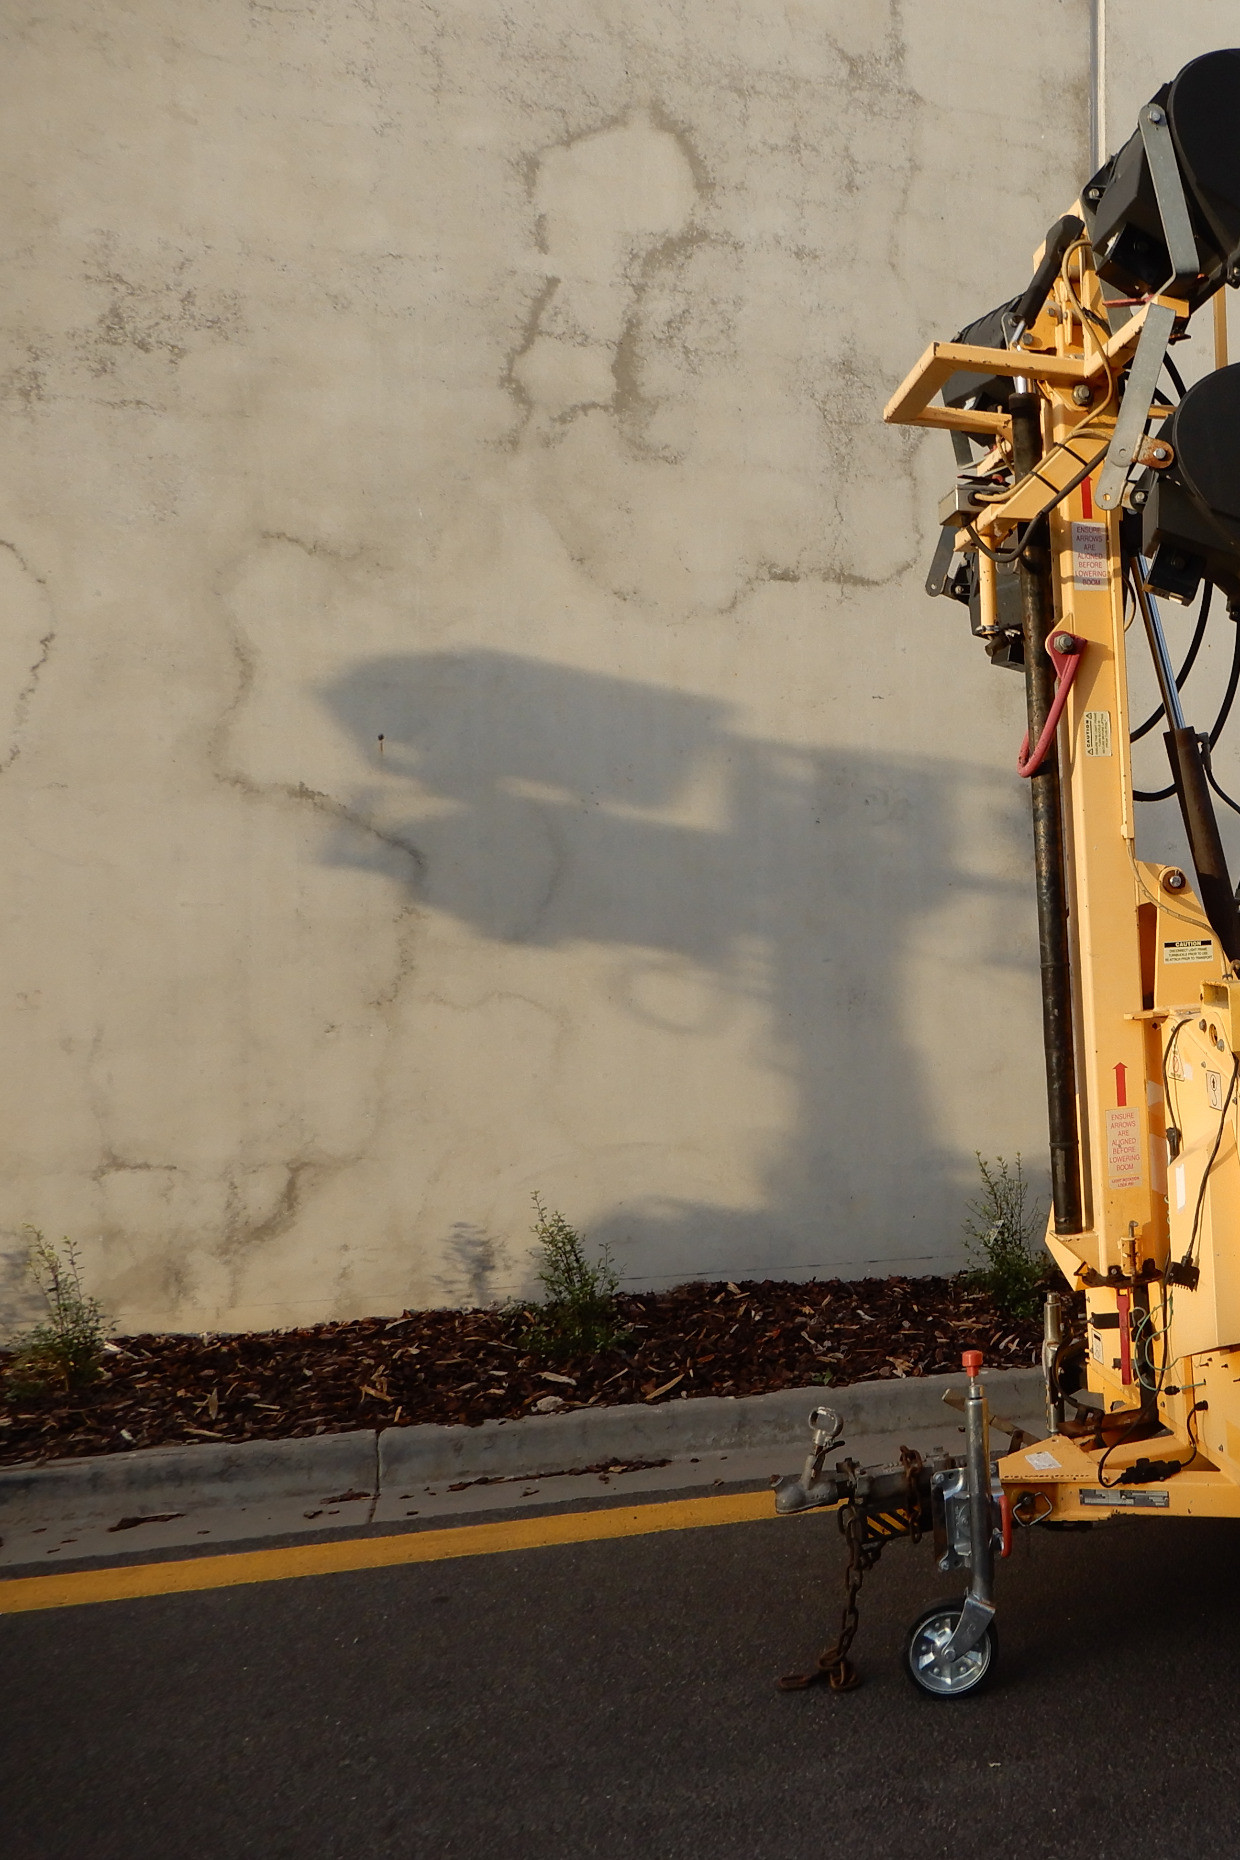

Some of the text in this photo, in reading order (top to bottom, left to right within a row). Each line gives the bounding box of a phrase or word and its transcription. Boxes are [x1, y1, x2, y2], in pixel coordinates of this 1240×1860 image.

[1111, 1120, 1136, 1129] ARROWS
[1112, 1138, 1137, 1146] ALIGNED
[1109, 1154, 1140, 1163] LOWERING
